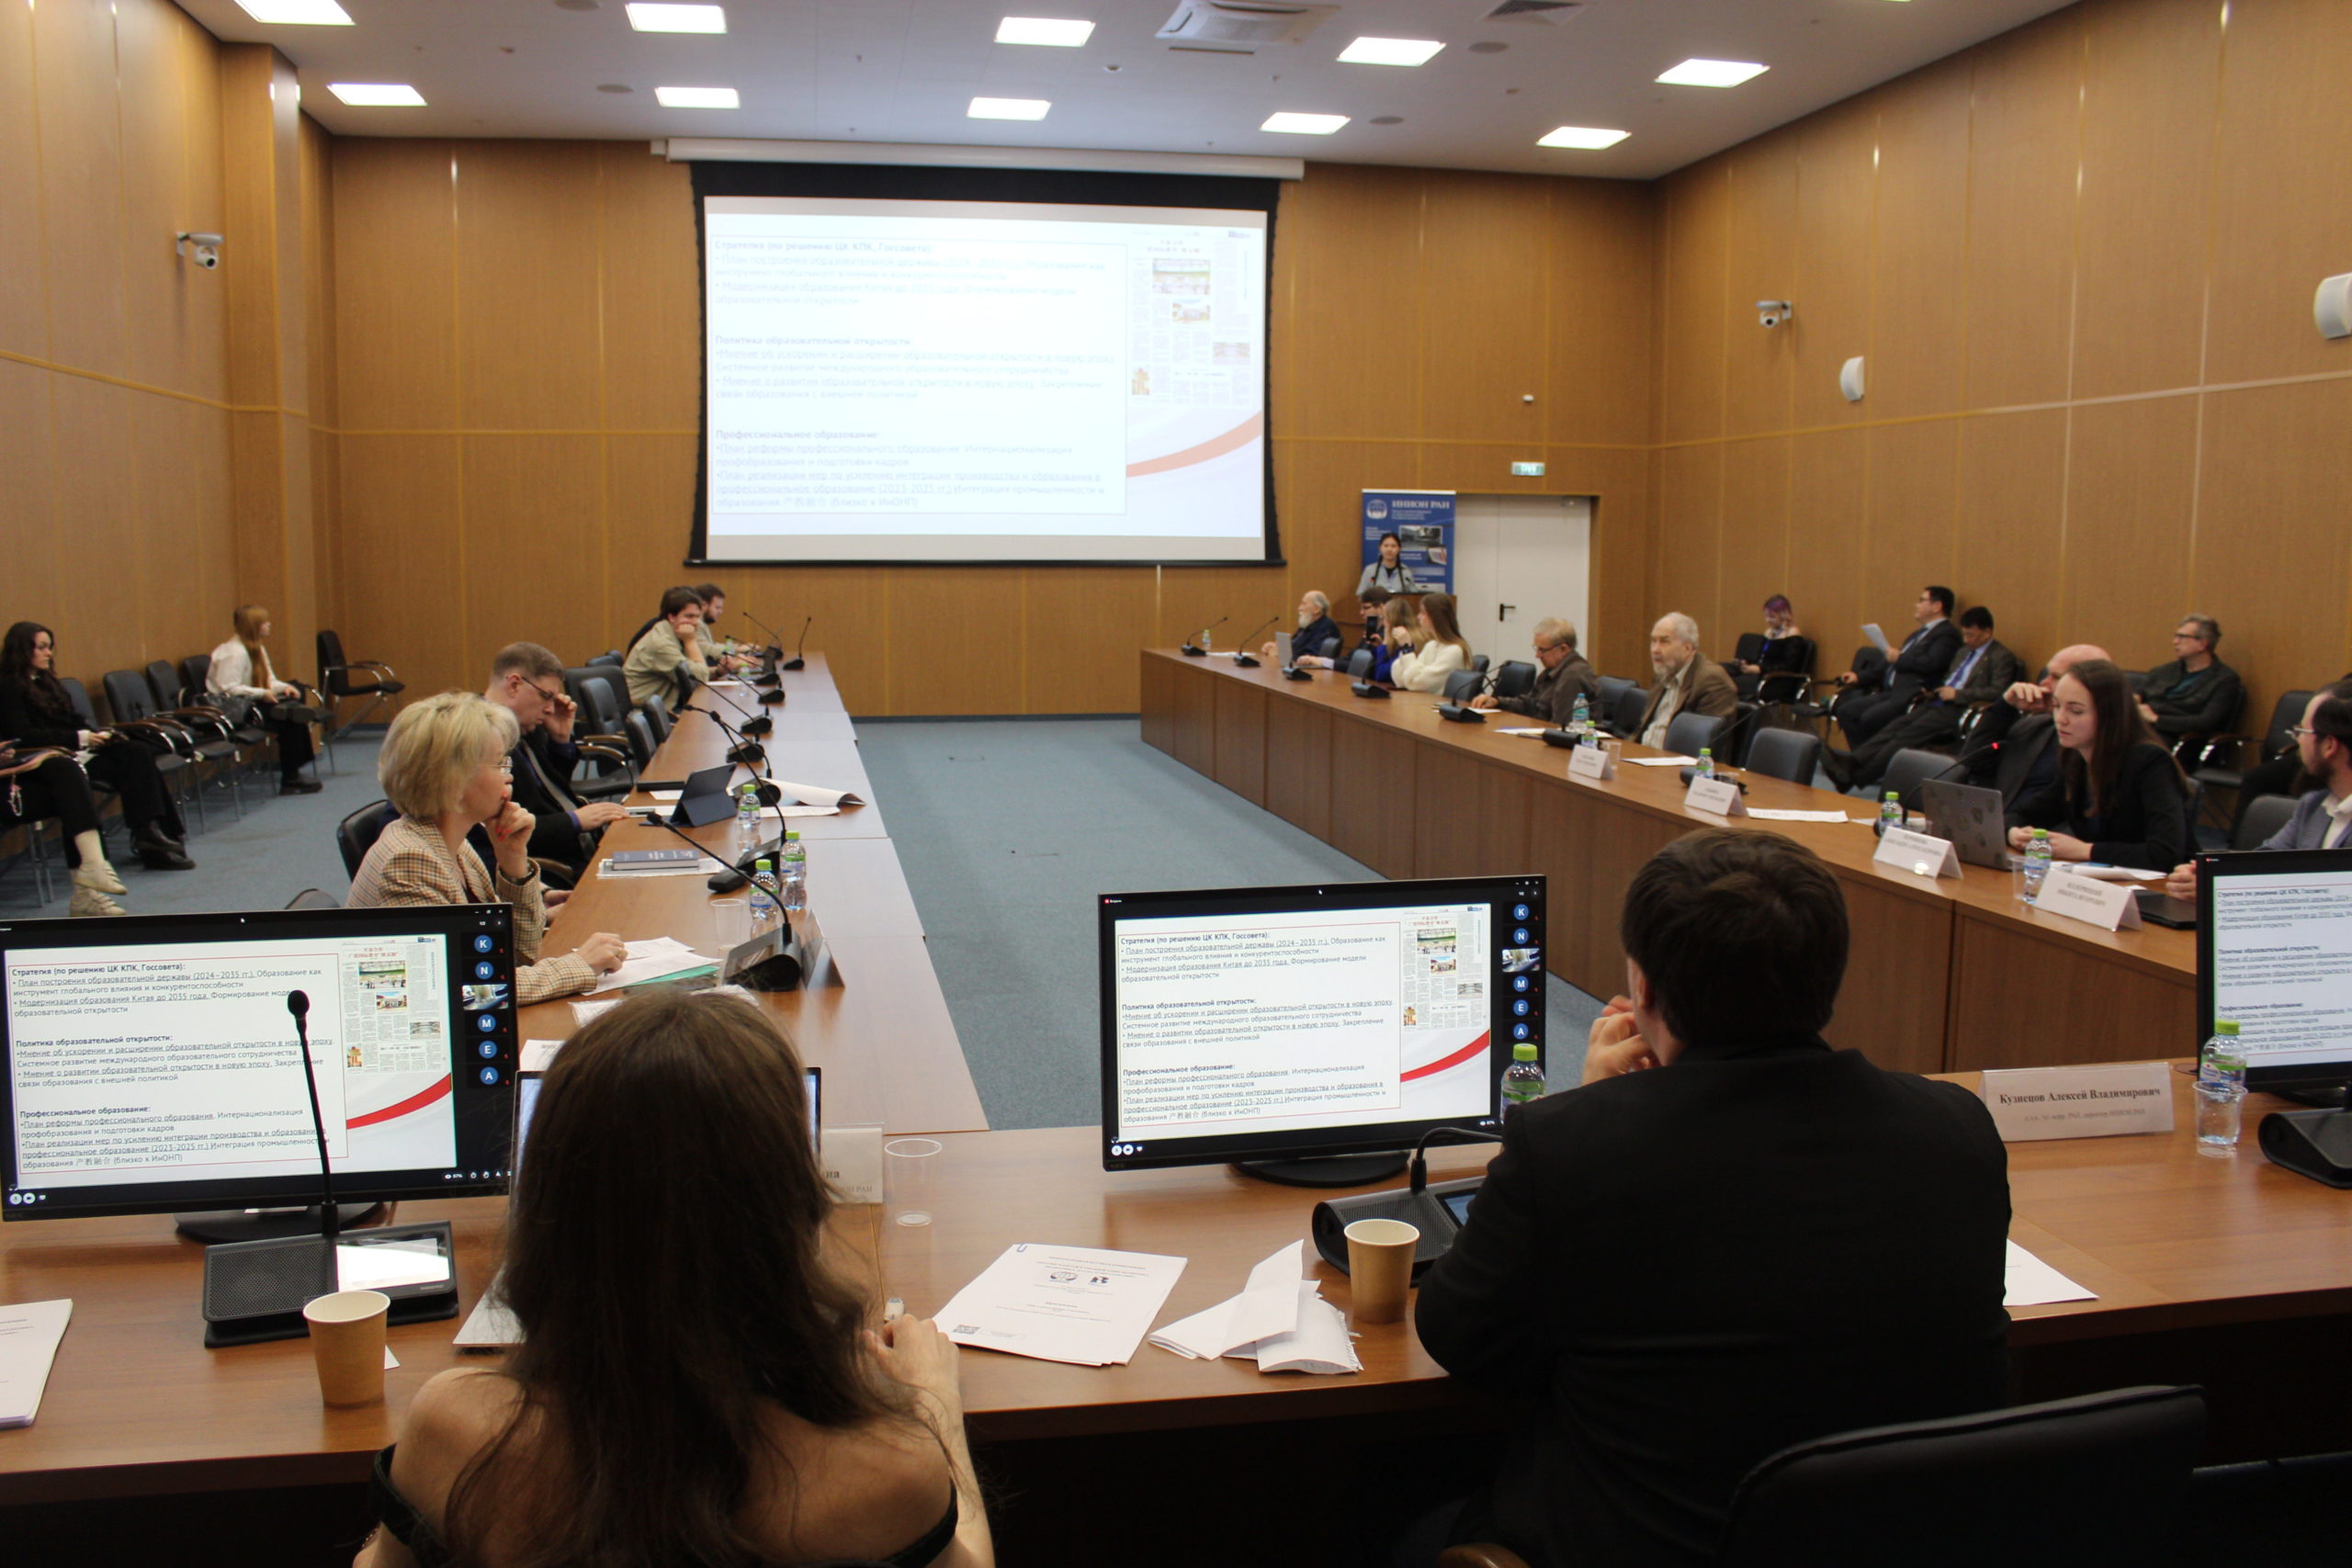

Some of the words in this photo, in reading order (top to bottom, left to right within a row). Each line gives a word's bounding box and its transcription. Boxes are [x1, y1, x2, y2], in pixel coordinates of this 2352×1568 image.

[1518, 908, 1525, 917] K
[480, 940, 488, 949] K
[1120, 936, 1155, 945] Стратегия
[1157, 935, 1168, 943] (по
[1215, 932, 1231, 941] КПК,
[1232, 931, 1271, 941] Госсовета):
[1125, 946, 1143, 954] План
[1185, 942, 1243, 952] образовательной
[1329, 936, 1373, 945] Образование
[1161, 953, 1204, 961] глобального
[1240, 947, 1318, 958] конкурентоспособности
[11, 967, 51, 977] Стратегия
[52, 966, 66, 976] (по
[107, 964, 119, 973] ЦК
[120, 964, 140, 972] КПК,
[141, 962, 187, 972] Госсовета):
[481, 966, 489, 976] N
[1125, 964, 1177, 974] Модернизация
[1178, 961, 1221, 971] образования
[1223, 960, 1242, 968] Китая
[1290, 955, 1340, 965] Формирование
[1121, 973, 1180, 983] образовательной
[1182, 972, 1219, 980] открытости
[1517, 980, 1525, 988] M
[60, 986, 108, 994] глобального
[151, 980, 243, 992] конкурентоспособности
[1121, 1002, 1154, 1010] Политика
[1156, 998, 1215, 1010] образовательной
[1216, 998, 1257, 1006] открытости:
[1125, 1011, 1151, 1020] Мнение
[1153, 1010, 1161, 1019] об
[1163, 1010, 1199, 1019] ускорении
[1207, 1008, 1248, 1016] расширении
[1250, 1003, 1306, 1013] образовательной
[1307, 1002, 1344, 1010] открытости
[14, 1007, 83, 1018] образовательной
[84, 1007, 129, 1015] открытости
[1122, 1021, 1159, 1029] Системное
[1193, 1017, 1250, 1026] международного
[1250, 1012, 1309, 1022] образовательного
[1310, 1010, 1362, 1019] сотрудничества
[481, 1020, 492, 1028] M
[1126, 1030, 1154, 1039] Мнение
[1194, 1024, 1251, 1035] образовательной
[1341, 1017, 1384, 1027] Закрепление
[1517, 1027, 1525, 1035] A
[15, 1038, 53, 1047] Политика
[55, 1035, 123, 1046] образовательной
[125, 1035, 173, 1043] открытости:
[1143, 1037, 1187, 1047] образования
[1193, 1035, 1223, 1043] внешней
[1225, 1033, 1260, 1042] политикой
[484, 1045, 492, 1055] E
[485, 1072, 493, 1080] A
[1123, 1065, 1188, 1077] Профессиональное
[1190, 1062, 1236, 1073] образование:
[1125, 1077, 1143, 1086] План
[1144, 1076, 1177, 1085] реформы
[1178, 1071, 1245, 1083] профессионального
[1291, 1063, 1364, 1076] Интернационализация
[1123, 1084, 1184, 1096] профобразования
[1125, 1096, 1143, 1104] План
[1144, 1095, 1185, 1103] реализации
[1245, 1089, 1283, 1097] интеграции
[1284, 1085, 1329, 1094] производства
[1336, 1080, 1378, 1090] образования
[1999, 1093, 2045, 1106] Кузнецов
[2048, 1090, 2087, 1101] Алексей
[2090, 1088, 2161, 1101] Владимирович
[1123, 1102, 1188, 1114] профессиональное
[1189, 1100, 1232, 1110] образование
[1284, 1093, 1323, 1103] Интеграция
[1324, 1090, 1381, 1100] промышленности
[19, 1107, 96, 1119] Профессиональное
[97, 1104, 151, 1115] образование:
[1123, 1113, 1168, 1123] образования
[1201, 1109, 1227, 1118] (близко
[22, 1158, 74, 1169] образования
[112, 1155, 142, 1165] (близко
